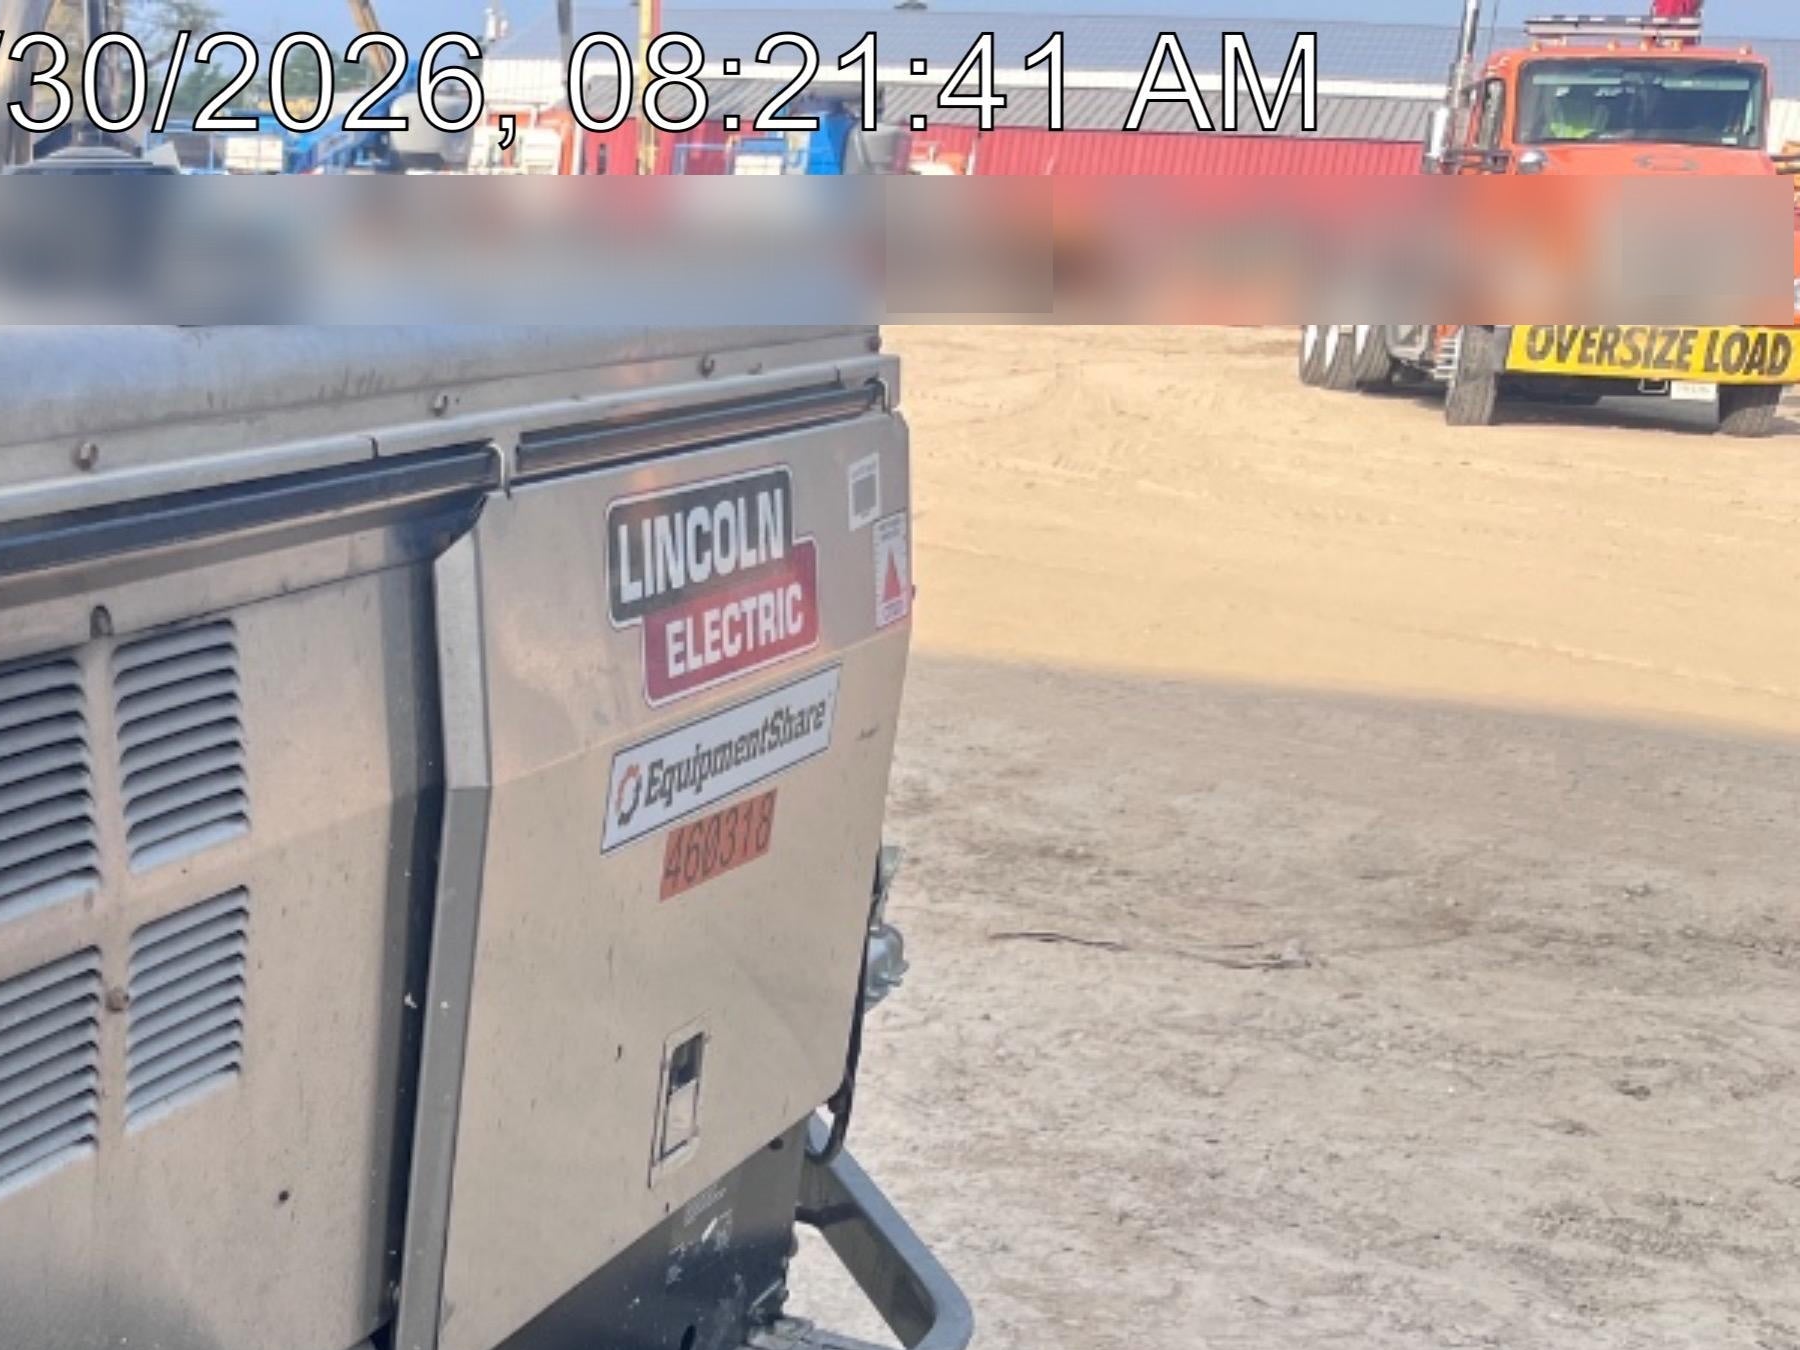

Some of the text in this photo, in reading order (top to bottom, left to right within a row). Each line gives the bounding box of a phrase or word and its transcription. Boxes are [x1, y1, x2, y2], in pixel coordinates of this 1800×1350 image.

[1526, 325, 1793, 376] OVERSIZE LOAD
[616, 487, 785, 604] LINCOLN
[664, 581, 805, 680] ELECTRIC
[643, 698, 827, 811] EquipmentShare
